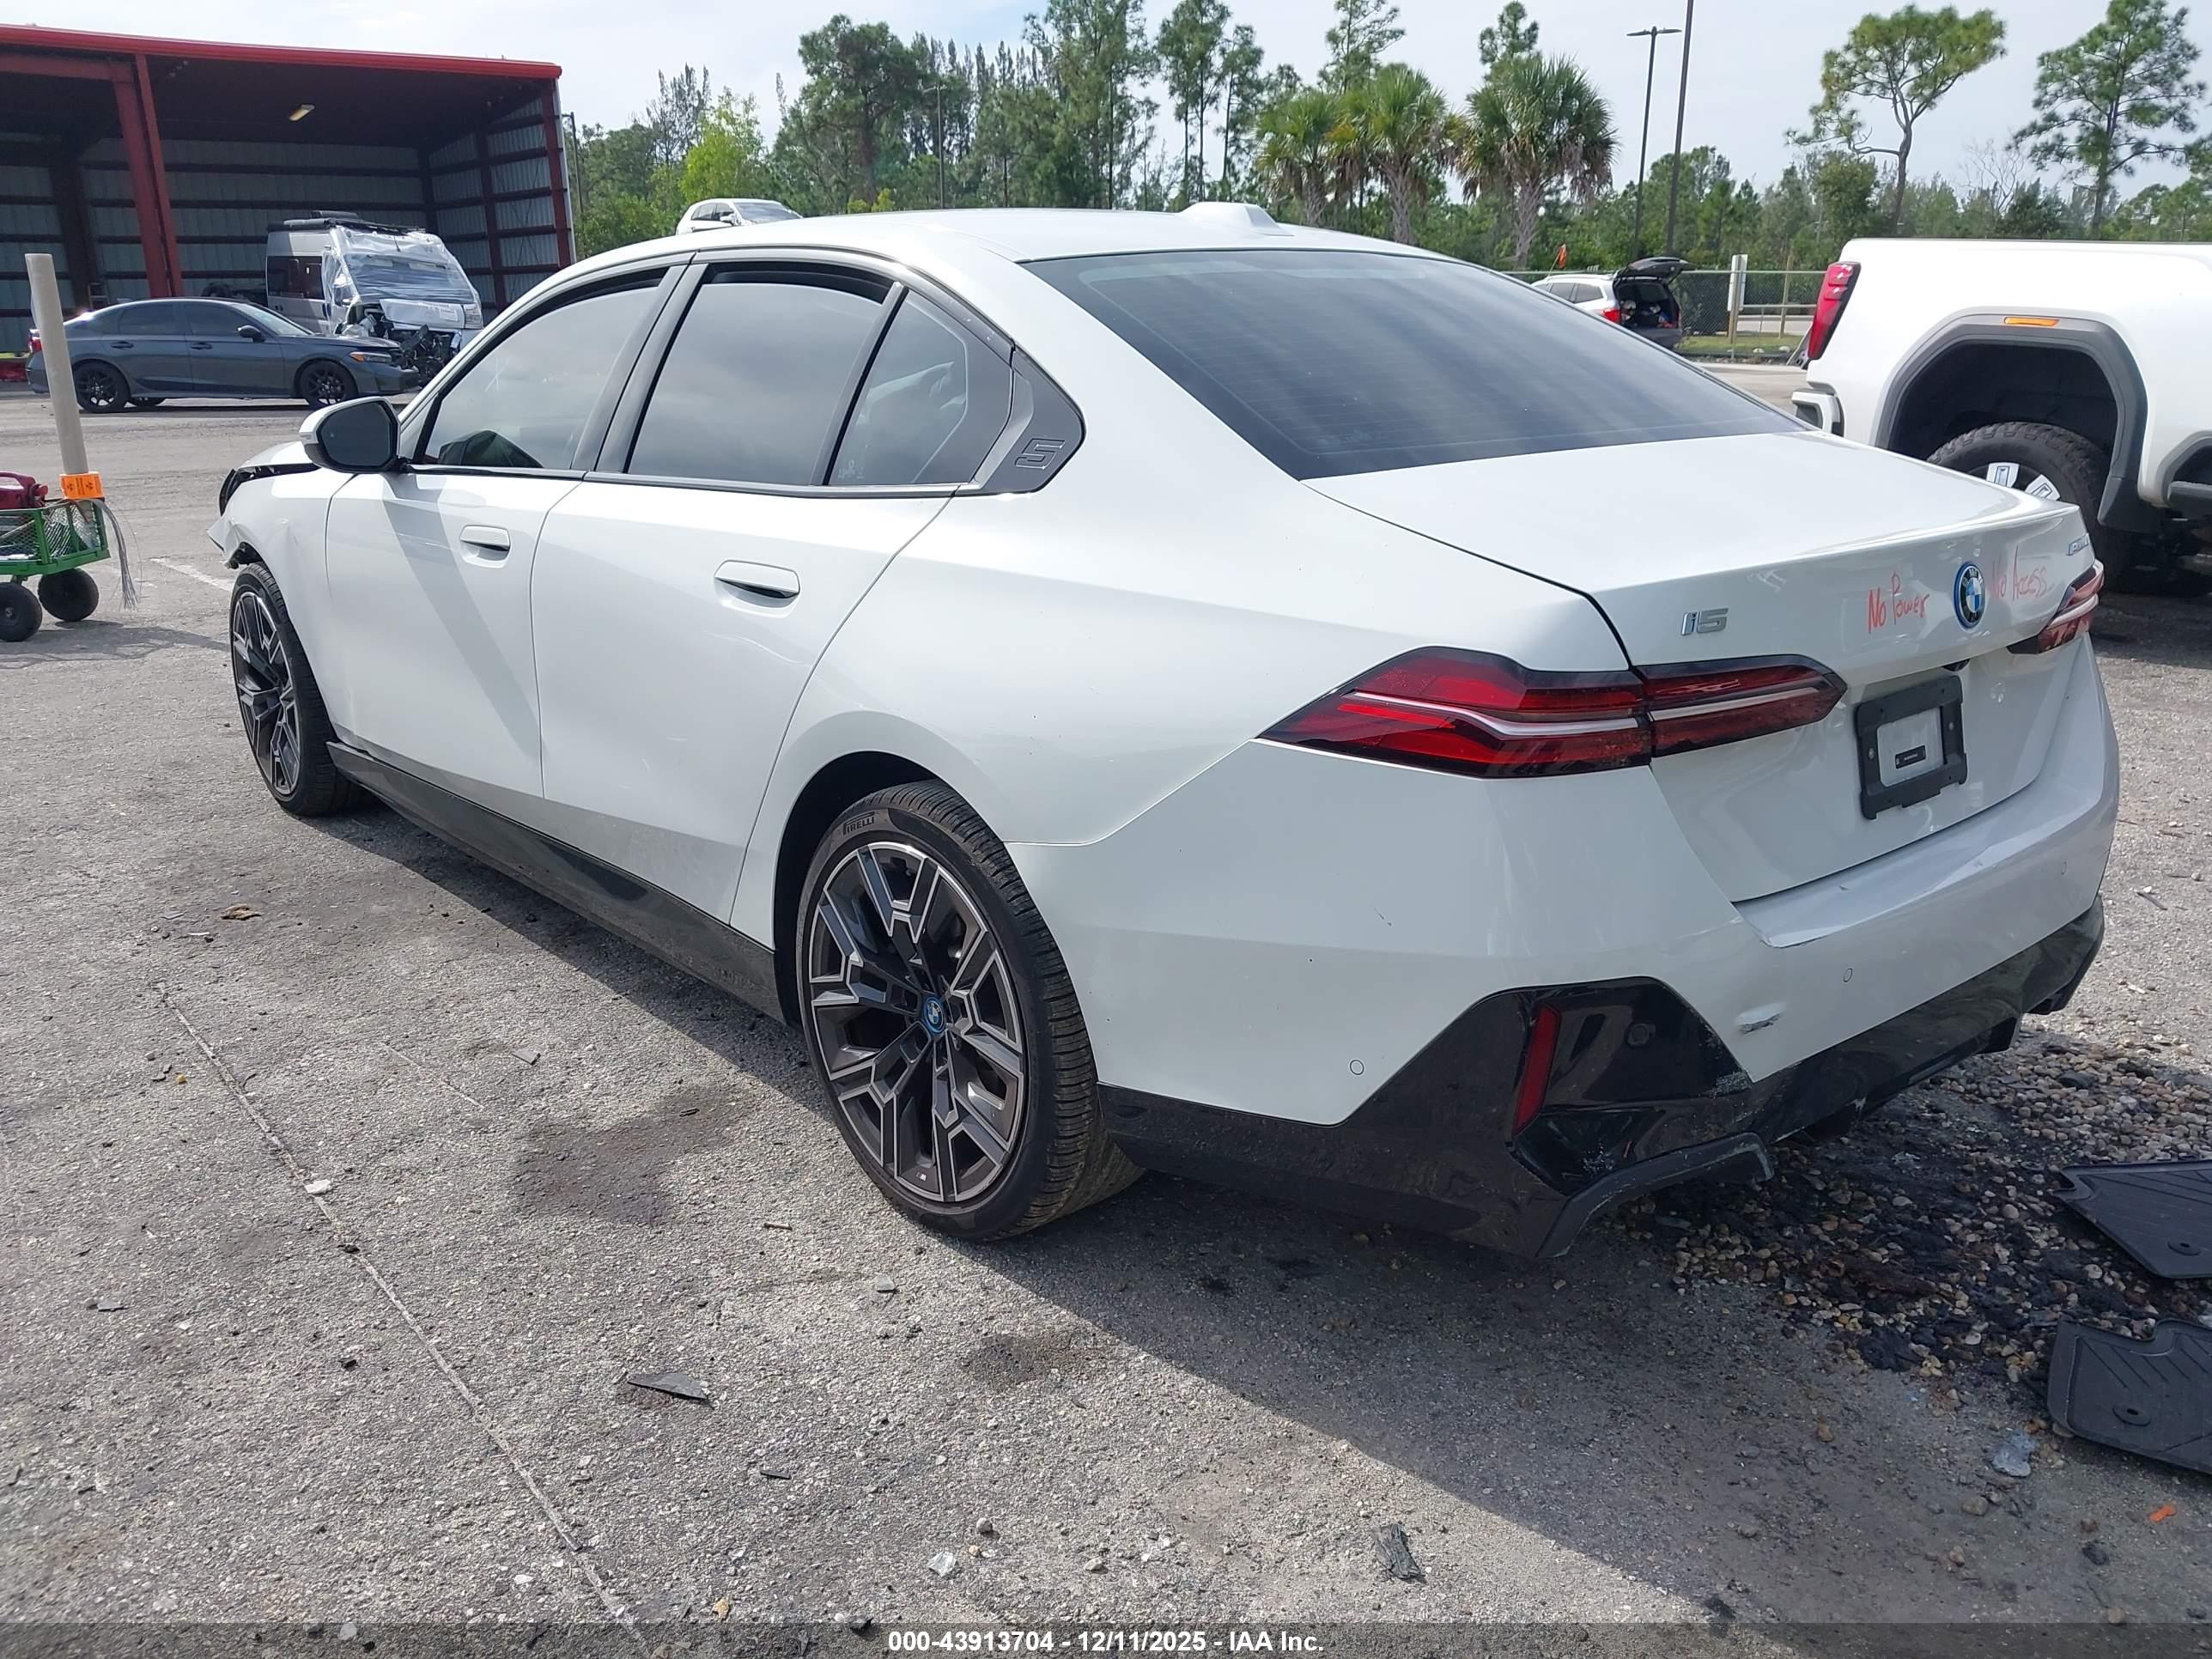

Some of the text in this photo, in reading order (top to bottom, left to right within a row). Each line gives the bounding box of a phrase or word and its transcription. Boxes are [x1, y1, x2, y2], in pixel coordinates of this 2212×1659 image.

[1869, 571, 1929, 634] No Power
[1681, 607, 1729, 635] i5
[843, 811, 876, 836] PIRELLI
